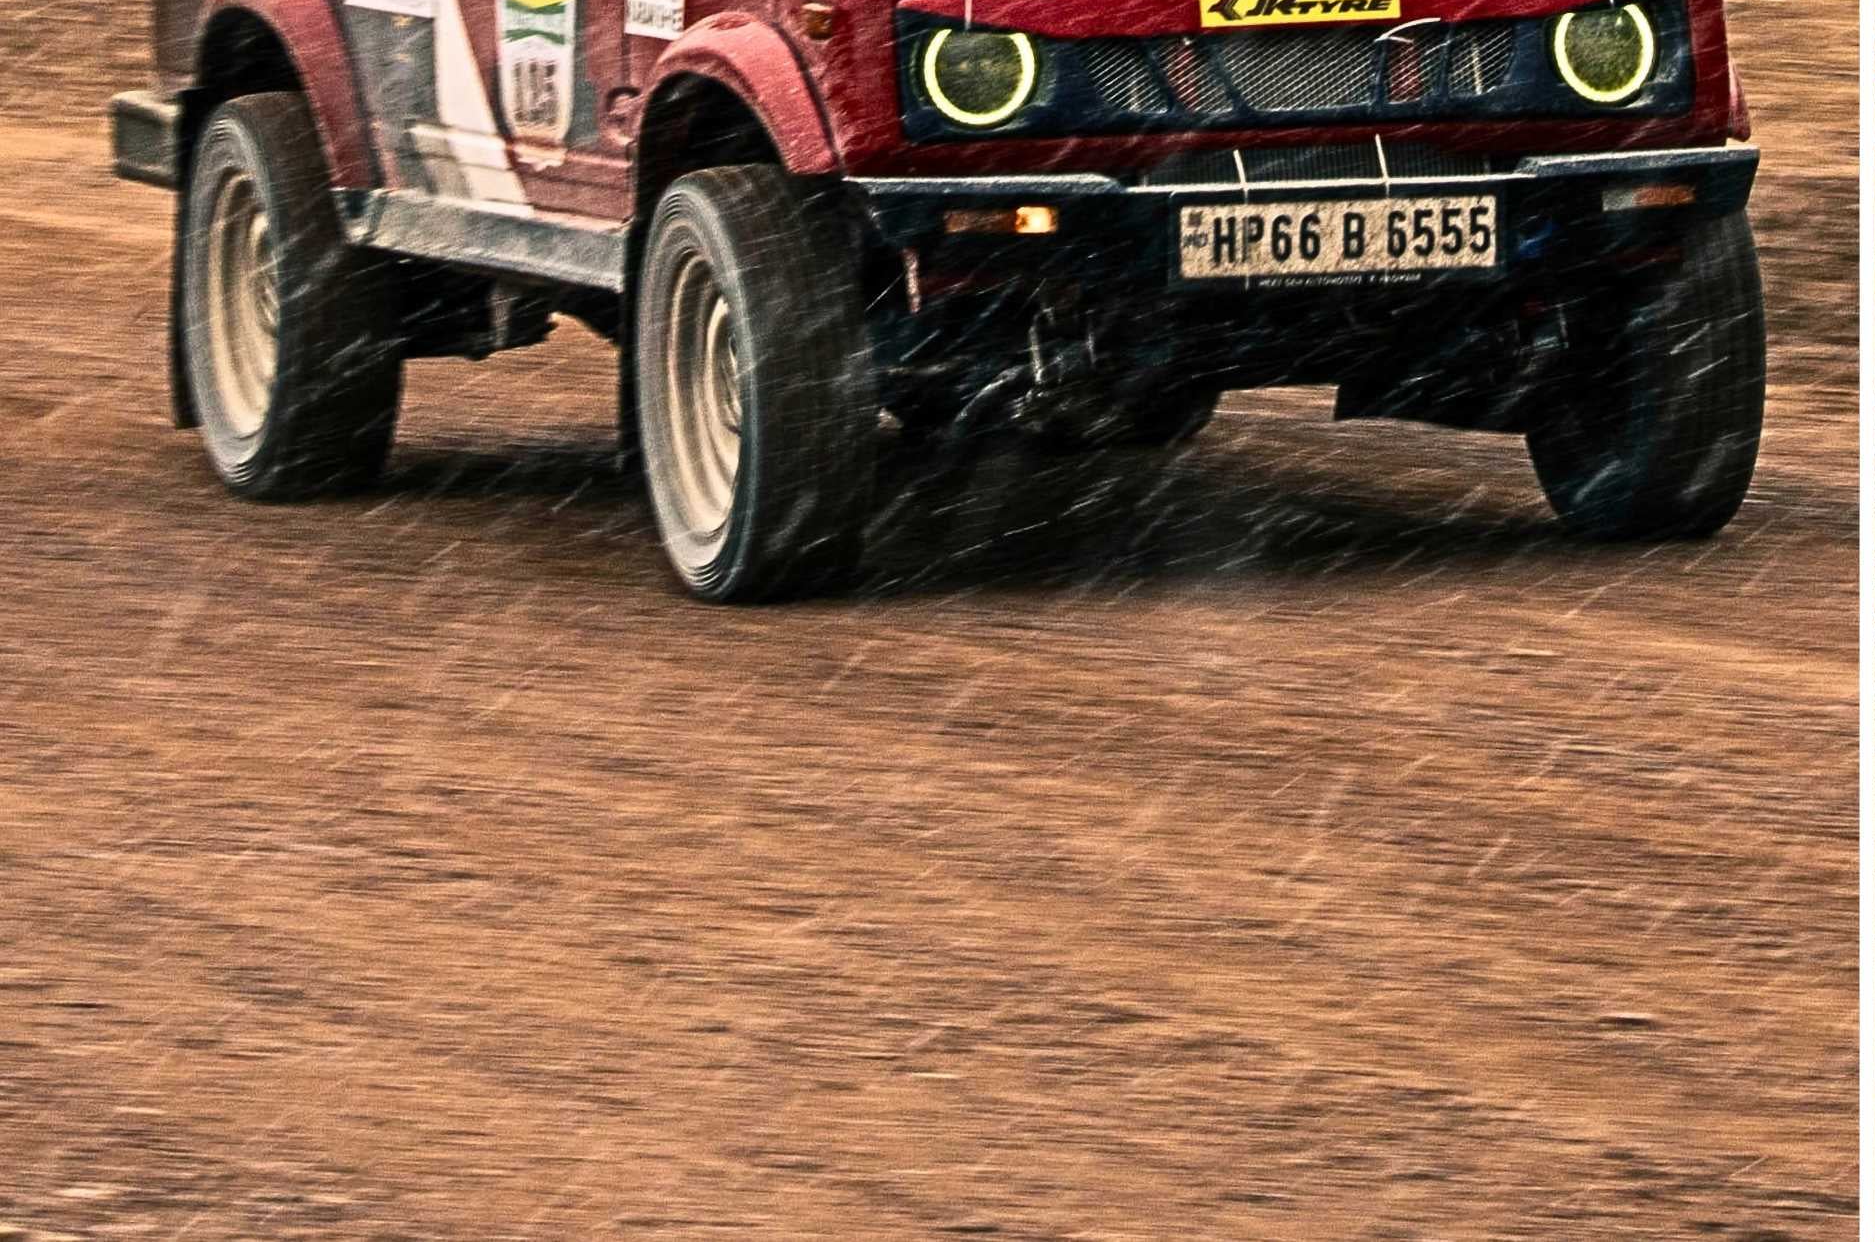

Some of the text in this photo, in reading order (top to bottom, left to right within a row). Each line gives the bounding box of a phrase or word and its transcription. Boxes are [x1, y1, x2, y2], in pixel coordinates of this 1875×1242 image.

[1213, 206, 1491, 264] HP66 B 6555
